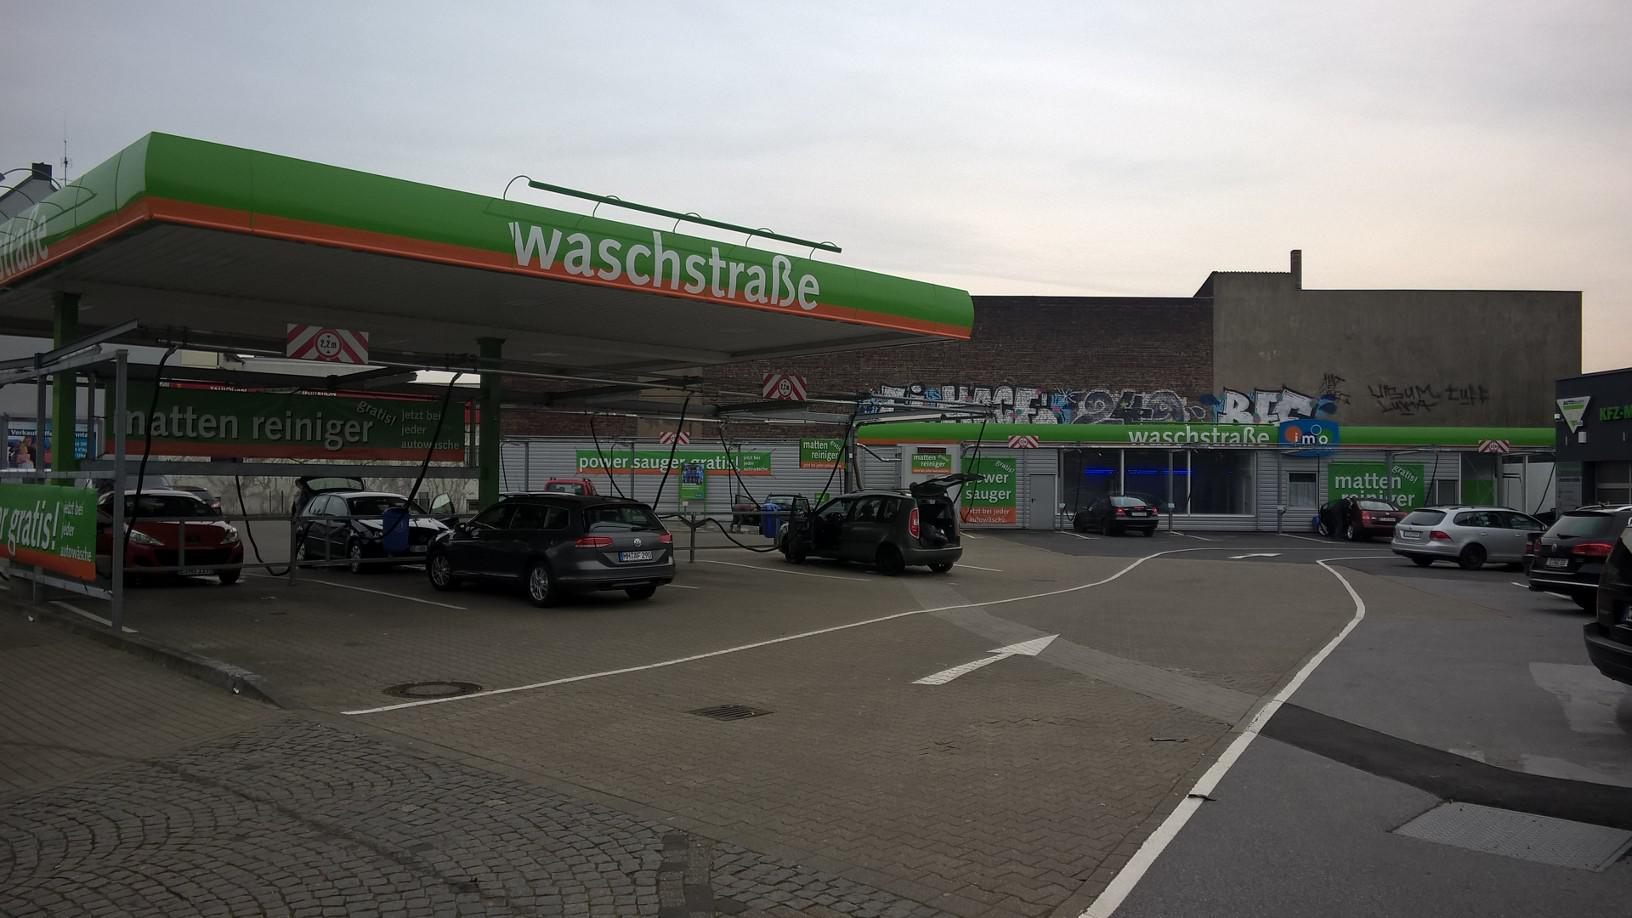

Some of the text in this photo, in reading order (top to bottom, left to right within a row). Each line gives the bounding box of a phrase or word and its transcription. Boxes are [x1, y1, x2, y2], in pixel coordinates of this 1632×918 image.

[508, 222, 820, 310] waschstraße
[356, 401, 397, 425] gratis!
[252, 410, 374, 450] reiniger
[401, 425, 426, 436] jeder
[1128, 425, 1270, 445] waschstraße
[803, 441, 828, 449] matten
[579, 456, 628, 472] power
[1335, 473, 1402, 489] matten
[965, 490, 1012, 503] sauger
[8, 501, 60, 556] gratis!
